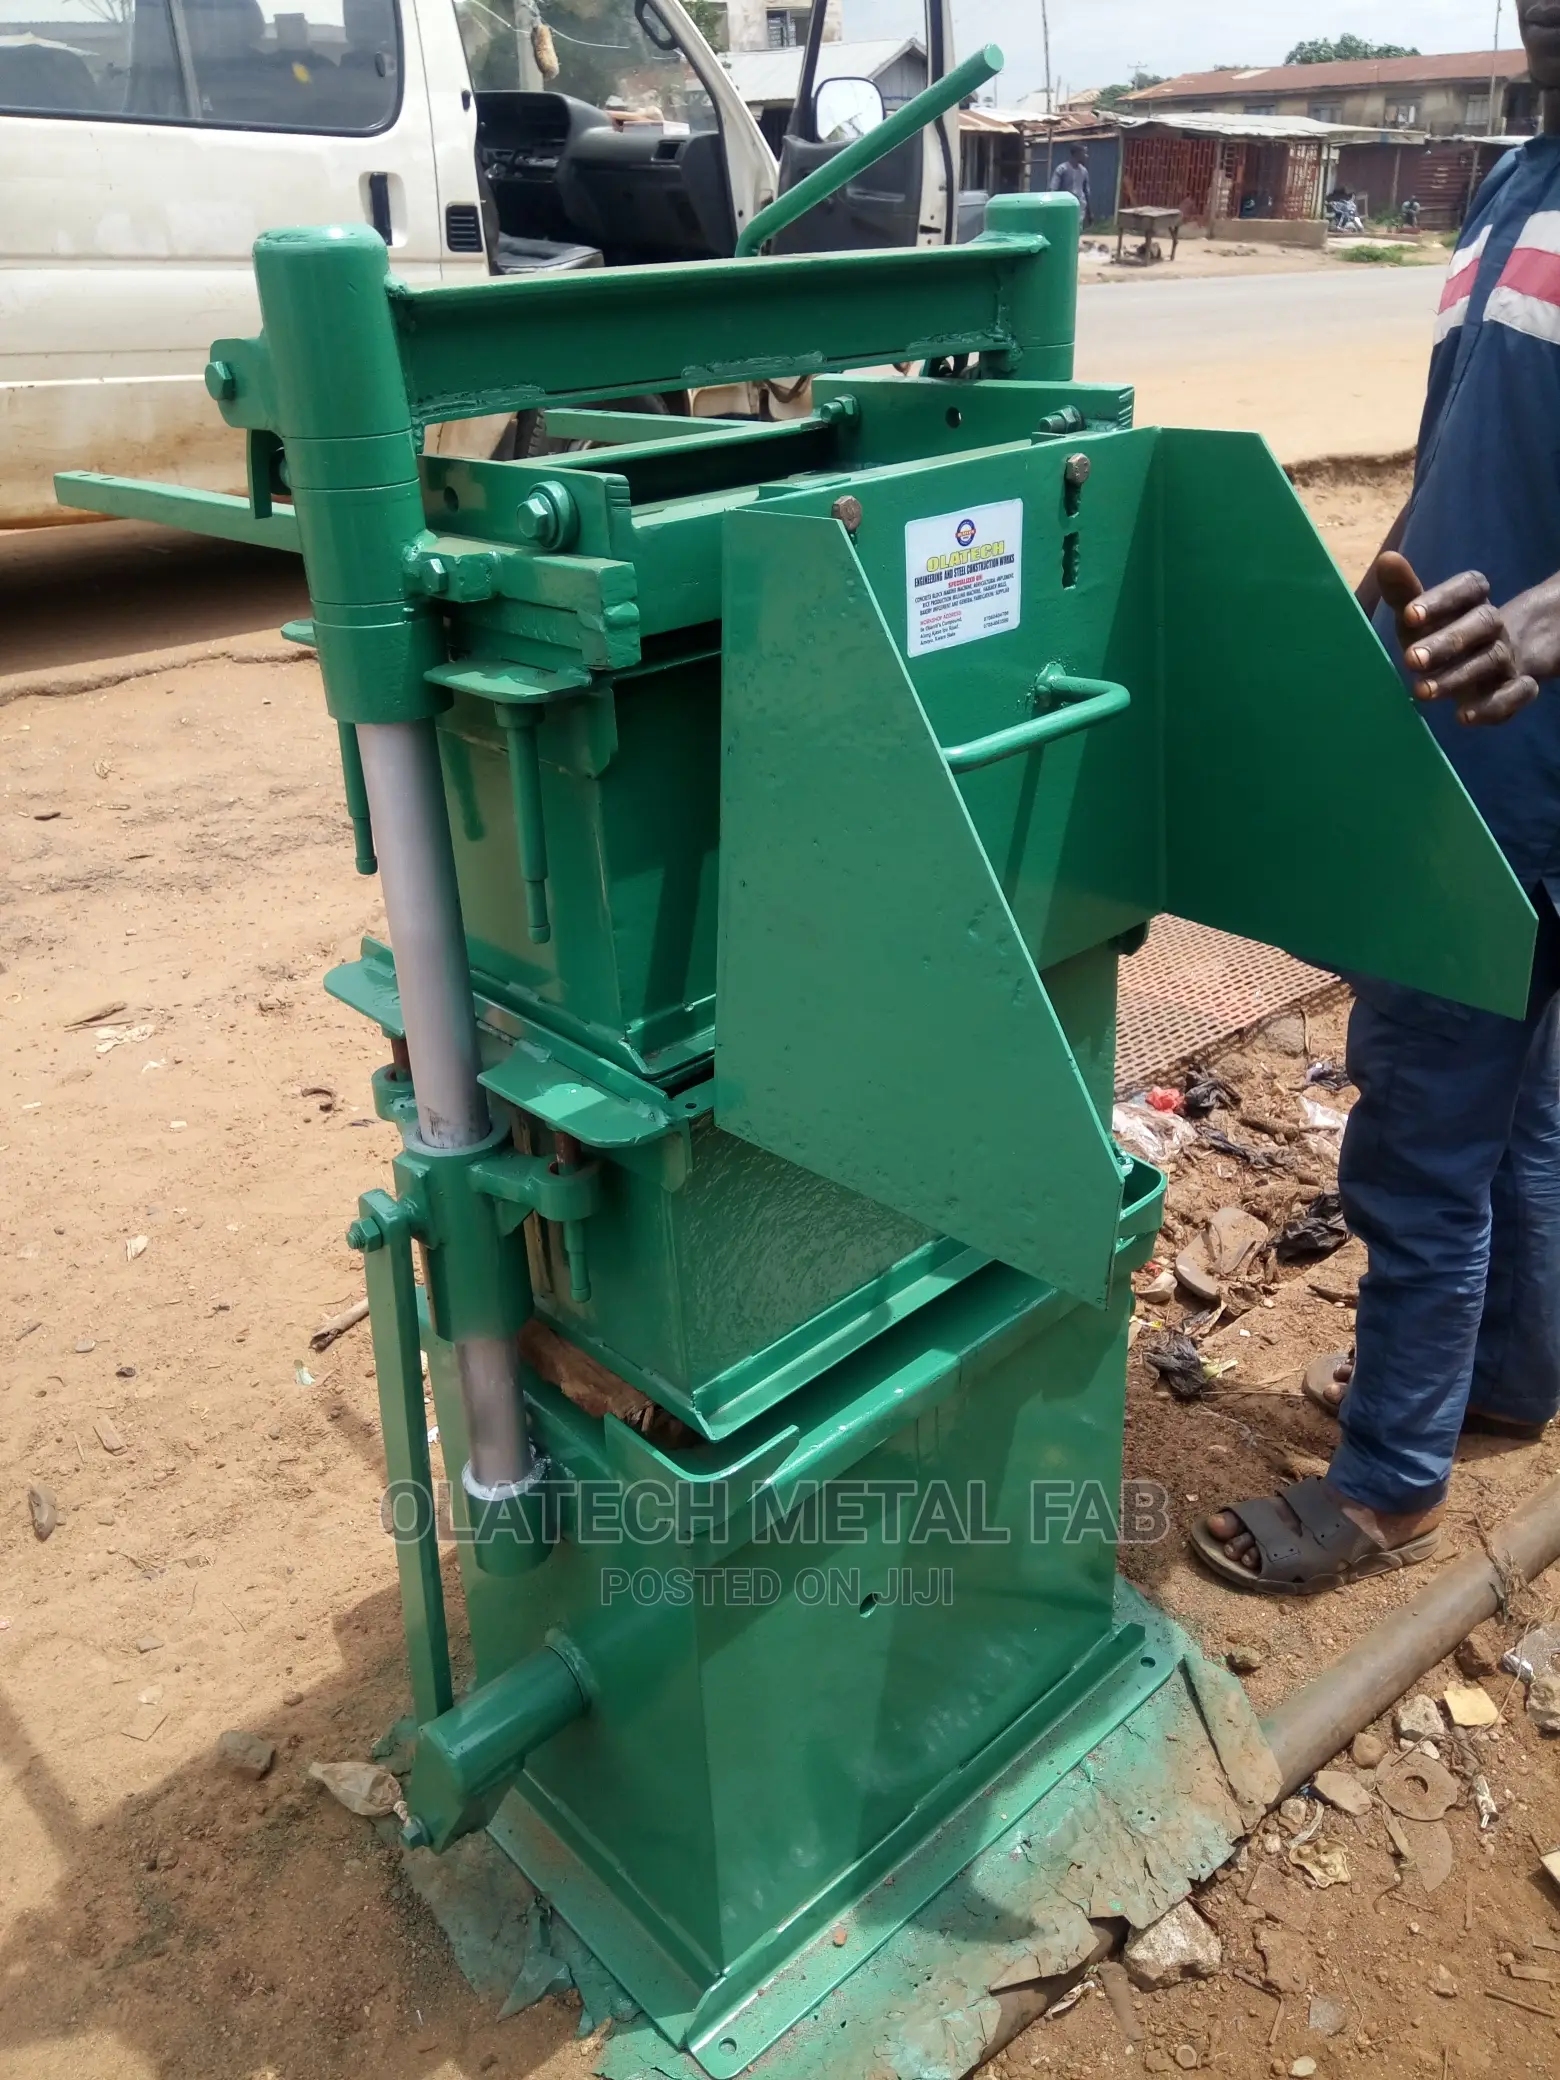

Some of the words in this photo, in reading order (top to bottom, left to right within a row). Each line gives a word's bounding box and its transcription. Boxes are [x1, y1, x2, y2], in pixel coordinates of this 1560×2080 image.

[915, 572, 942, 587] ENGINEERING
[944, 569, 953, 580] AND
[954, 566, 966, 577] STEEL
[967, 558, 999, 574] CONSTRUCTION
[1000, 554, 1014, 566] WORKS
[927, 541, 1004, 572] OLATECH
